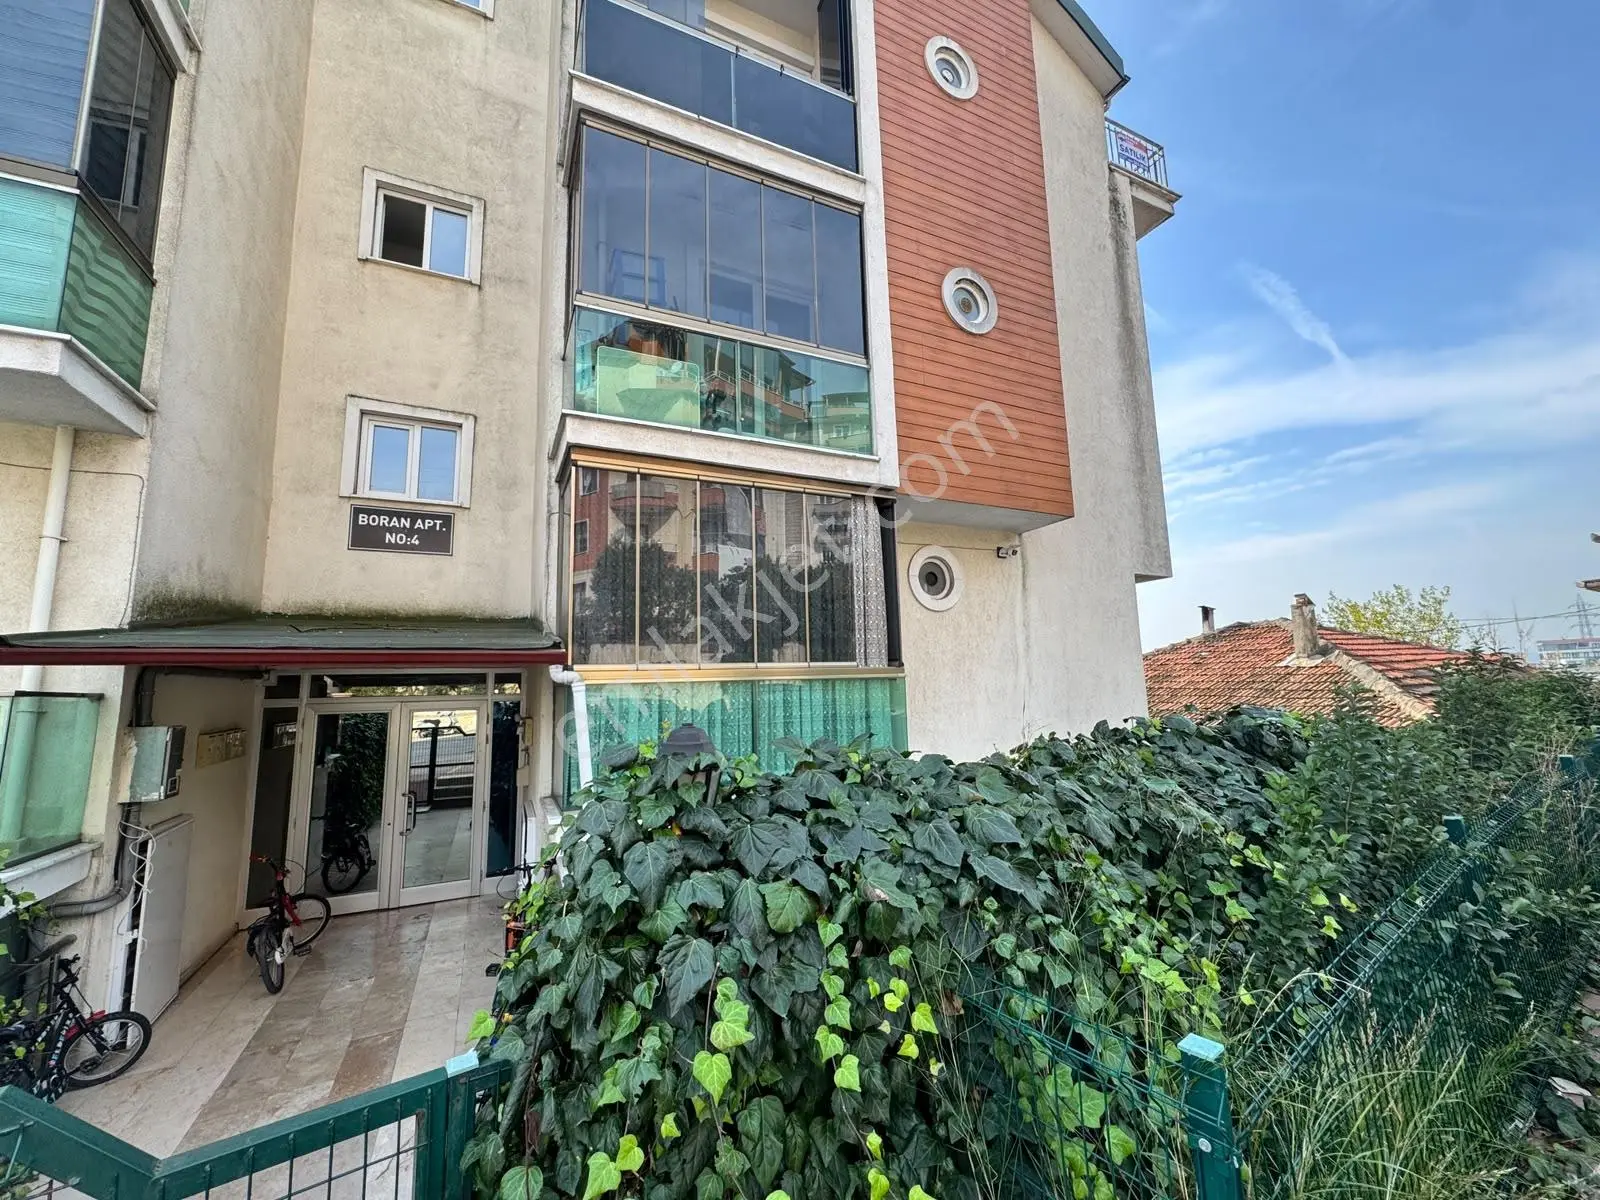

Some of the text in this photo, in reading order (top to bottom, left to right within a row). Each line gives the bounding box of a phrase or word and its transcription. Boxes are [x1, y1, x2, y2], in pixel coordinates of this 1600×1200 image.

[1119, 143, 1147, 161] SATILIK
[358, 513, 447, 532] BORAN APT.
[385, 532, 420, 546] NO:4
